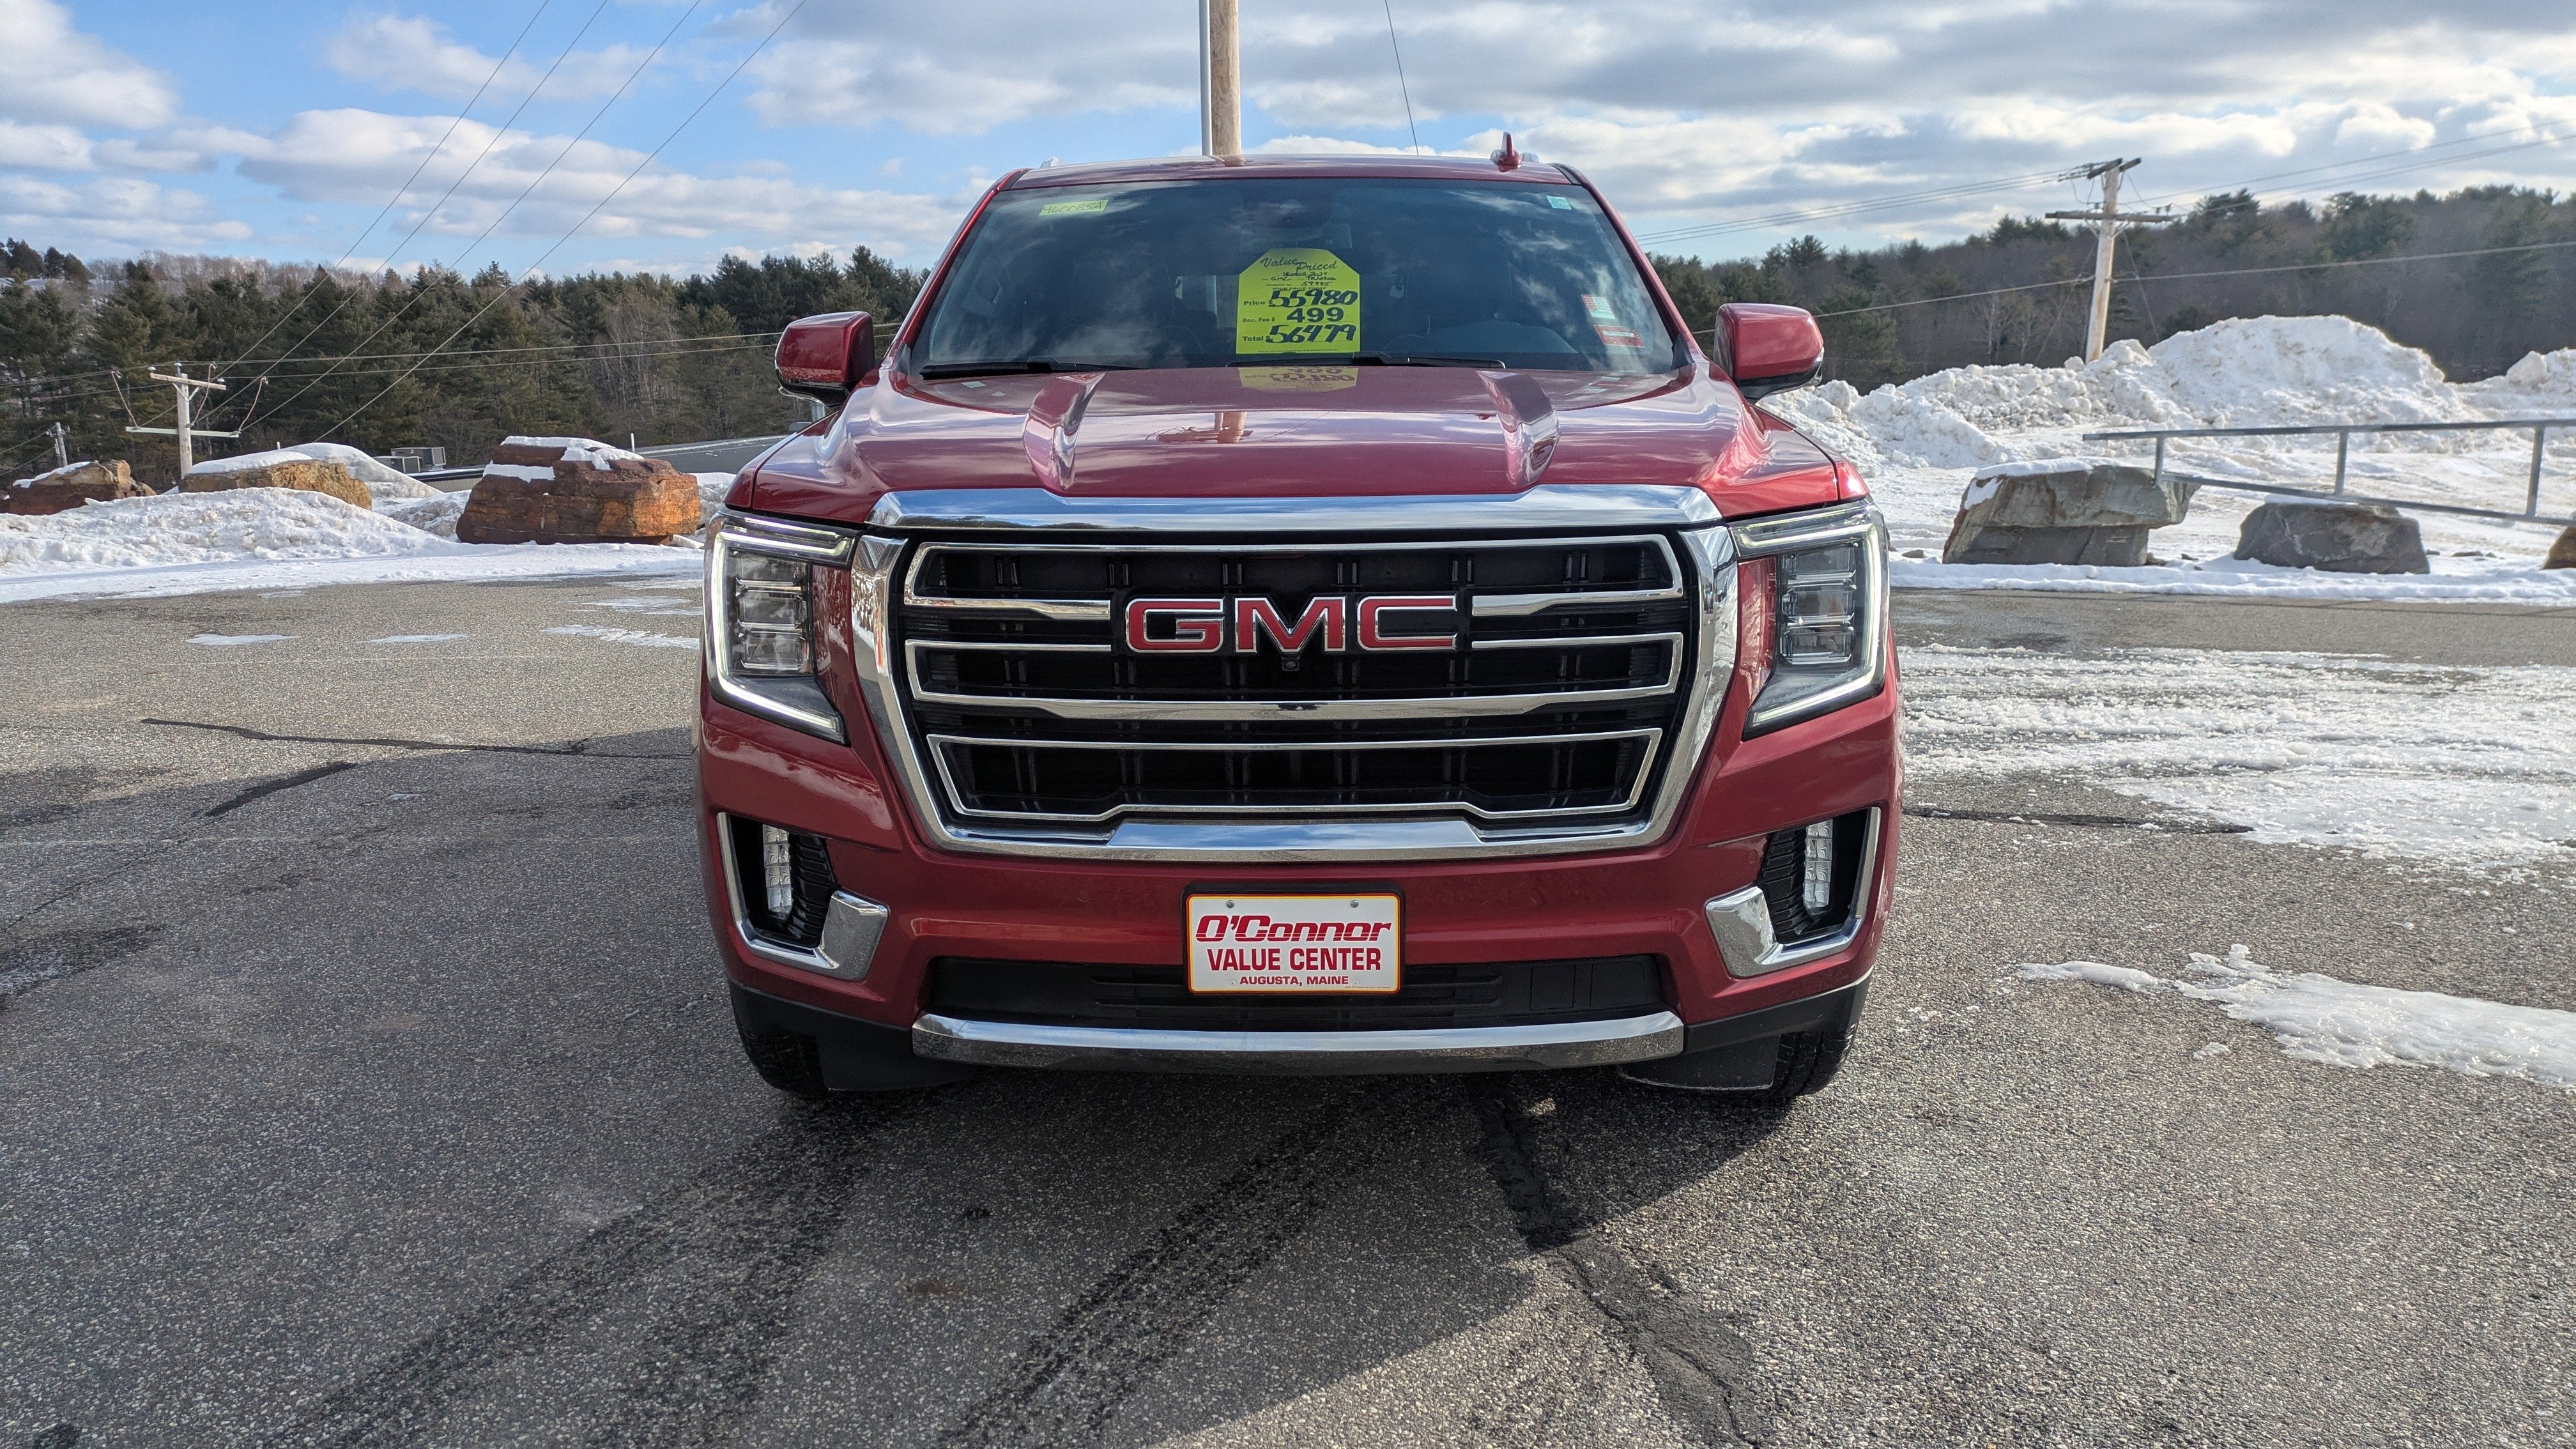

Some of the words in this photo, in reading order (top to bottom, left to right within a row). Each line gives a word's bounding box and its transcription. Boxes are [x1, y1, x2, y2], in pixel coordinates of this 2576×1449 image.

[1043, 202, 1102, 213] 460085A
[1261, 257, 1298, 268] Value
[1296, 261, 1337, 273] Priced
[1268, 289, 1358, 307] 55980
[1287, 307, 1344, 323] 499
[1265, 324, 1357, 343] 56479
[1126, 594, 1457, 654] GMC
[1195, 915, 1392, 942] O'Connor
[1207, 948, 1281, 971] VALUE
[1289, 947, 1381, 970] CENTER
[1239, 976, 1303, 986] AUGUSTA,
[1307, 976, 1349, 985] MAINE
